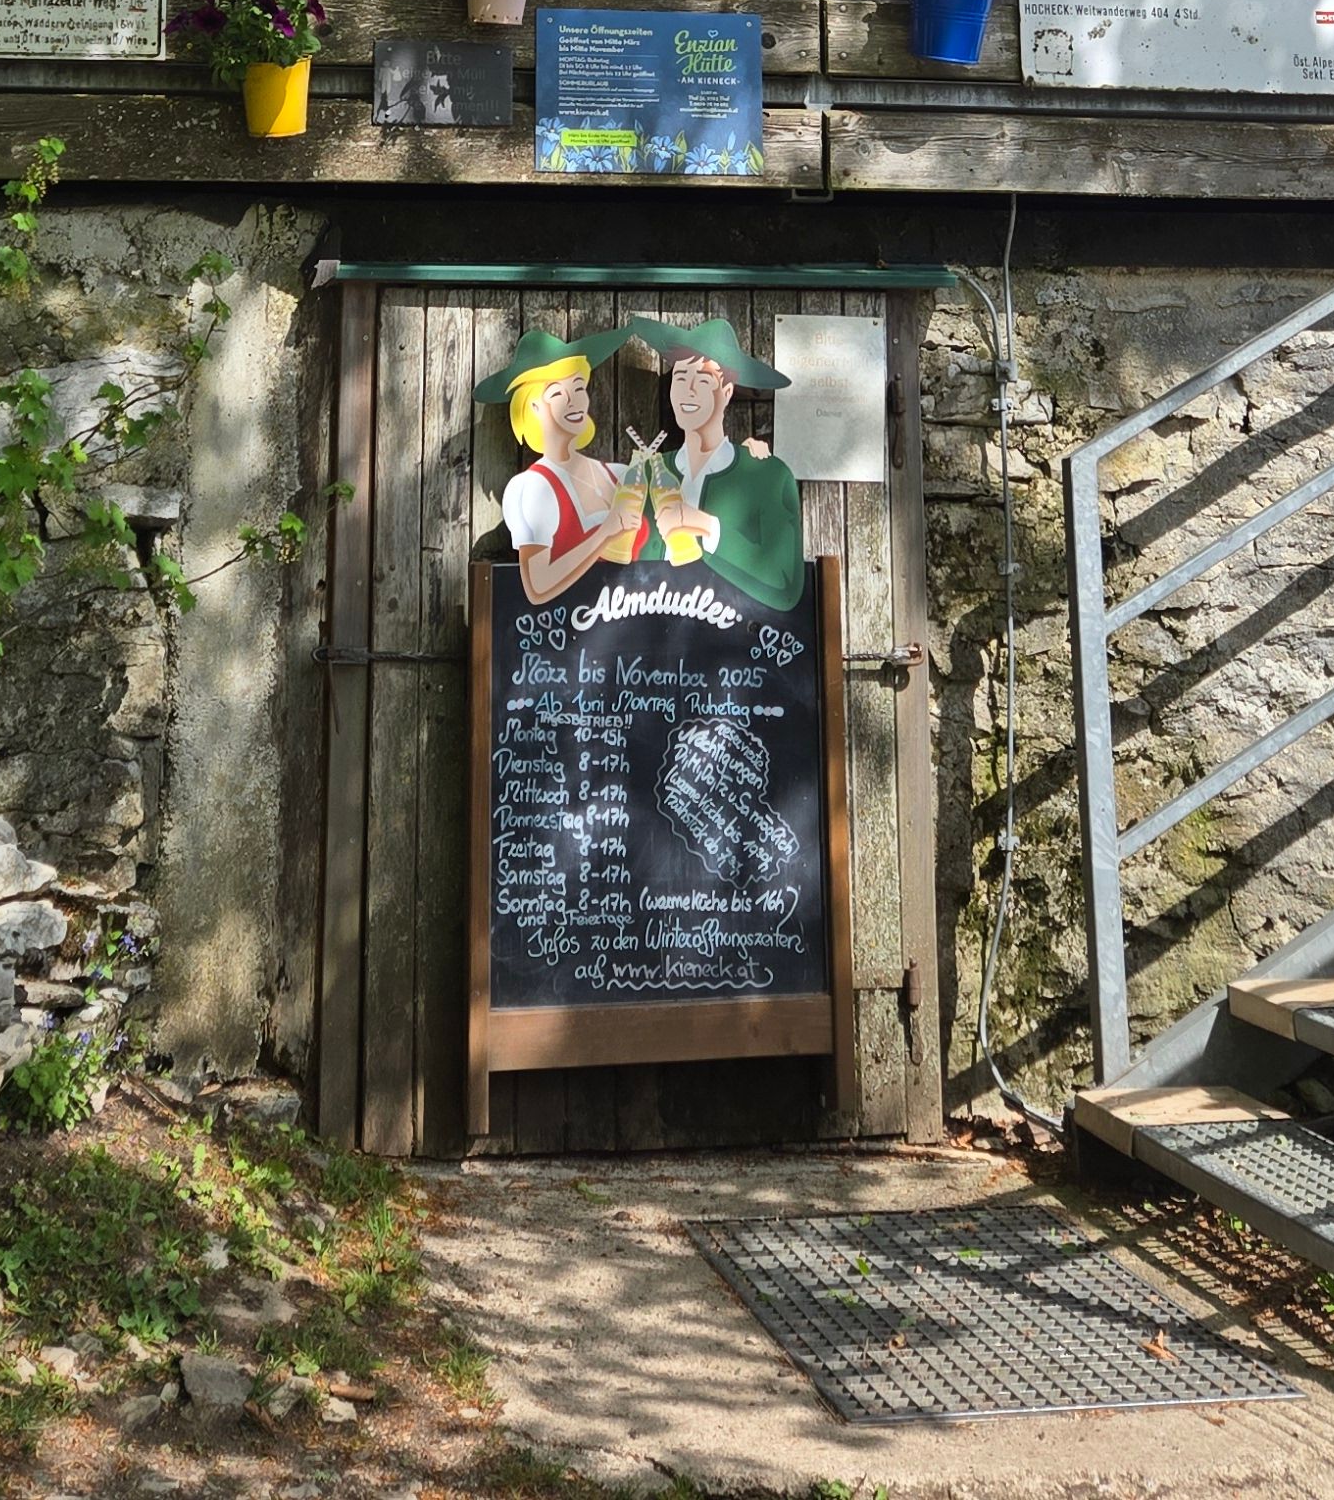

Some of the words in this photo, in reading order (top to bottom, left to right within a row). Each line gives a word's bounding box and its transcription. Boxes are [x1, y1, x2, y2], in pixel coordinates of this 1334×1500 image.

[1024, 3, 1073, 17] HOCHECK:
[1074, 4, 1147, 20] Weitwanderweg
[1150, 8, 1170, 19] 404
[1183, 8, 1202, 21] Std.
[558, 25, 589, 35] Unsere
[590, 24, 654, 37] Öffnungszeiten
[674, 29, 739, 55] Enzian
[676, 52, 737, 76] Hütte
[1293, 53, 1310, 67] Öst.
[1302, 68, 1326, 80] Sekt.
[681, 77, 695, 85] AM
[697, 77, 737, 86] KIENECK
[571, 581, 736, 632] Almdudler
[578, 648, 606, 684] bis
[617, 655, 709, 688] November
[717, 666, 768, 688] 2025
[535, 691, 563, 713] Ab
[684, 692, 750, 727] Ruhetag
[498, 717, 558, 754] Montag
[573, 727, 628, 748] 10-15h
[492, 748, 566, 783] Dienstag
[578, 752, 631, 774] 8-17h
[499, 778, 570, 805] Mittwoch
[578, 780, 628, 804] 8-17h
[493, 804, 585, 840] Donnerstag
[586, 804, 630, 829] 8-17h
[724, 816, 742, 844] bis
[492, 831, 556, 868] Freitag
[579, 835, 627, 858] 8-17h
[496, 859, 567, 896] Samstag
[579, 861, 631, 885] 8-17h
[496, 888, 567, 926] Sonntag
[578, 888, 632, 913] 8-17h
[731, 890, 753, 912] bis
[517, 912, 547, 928] und
[568, 909, 635, 930] Feiertage
[527, 927, 580, 966] Infos
[574, 954, 607, 990] auf
[612, 955, 758, 981] www.kieneck.at
